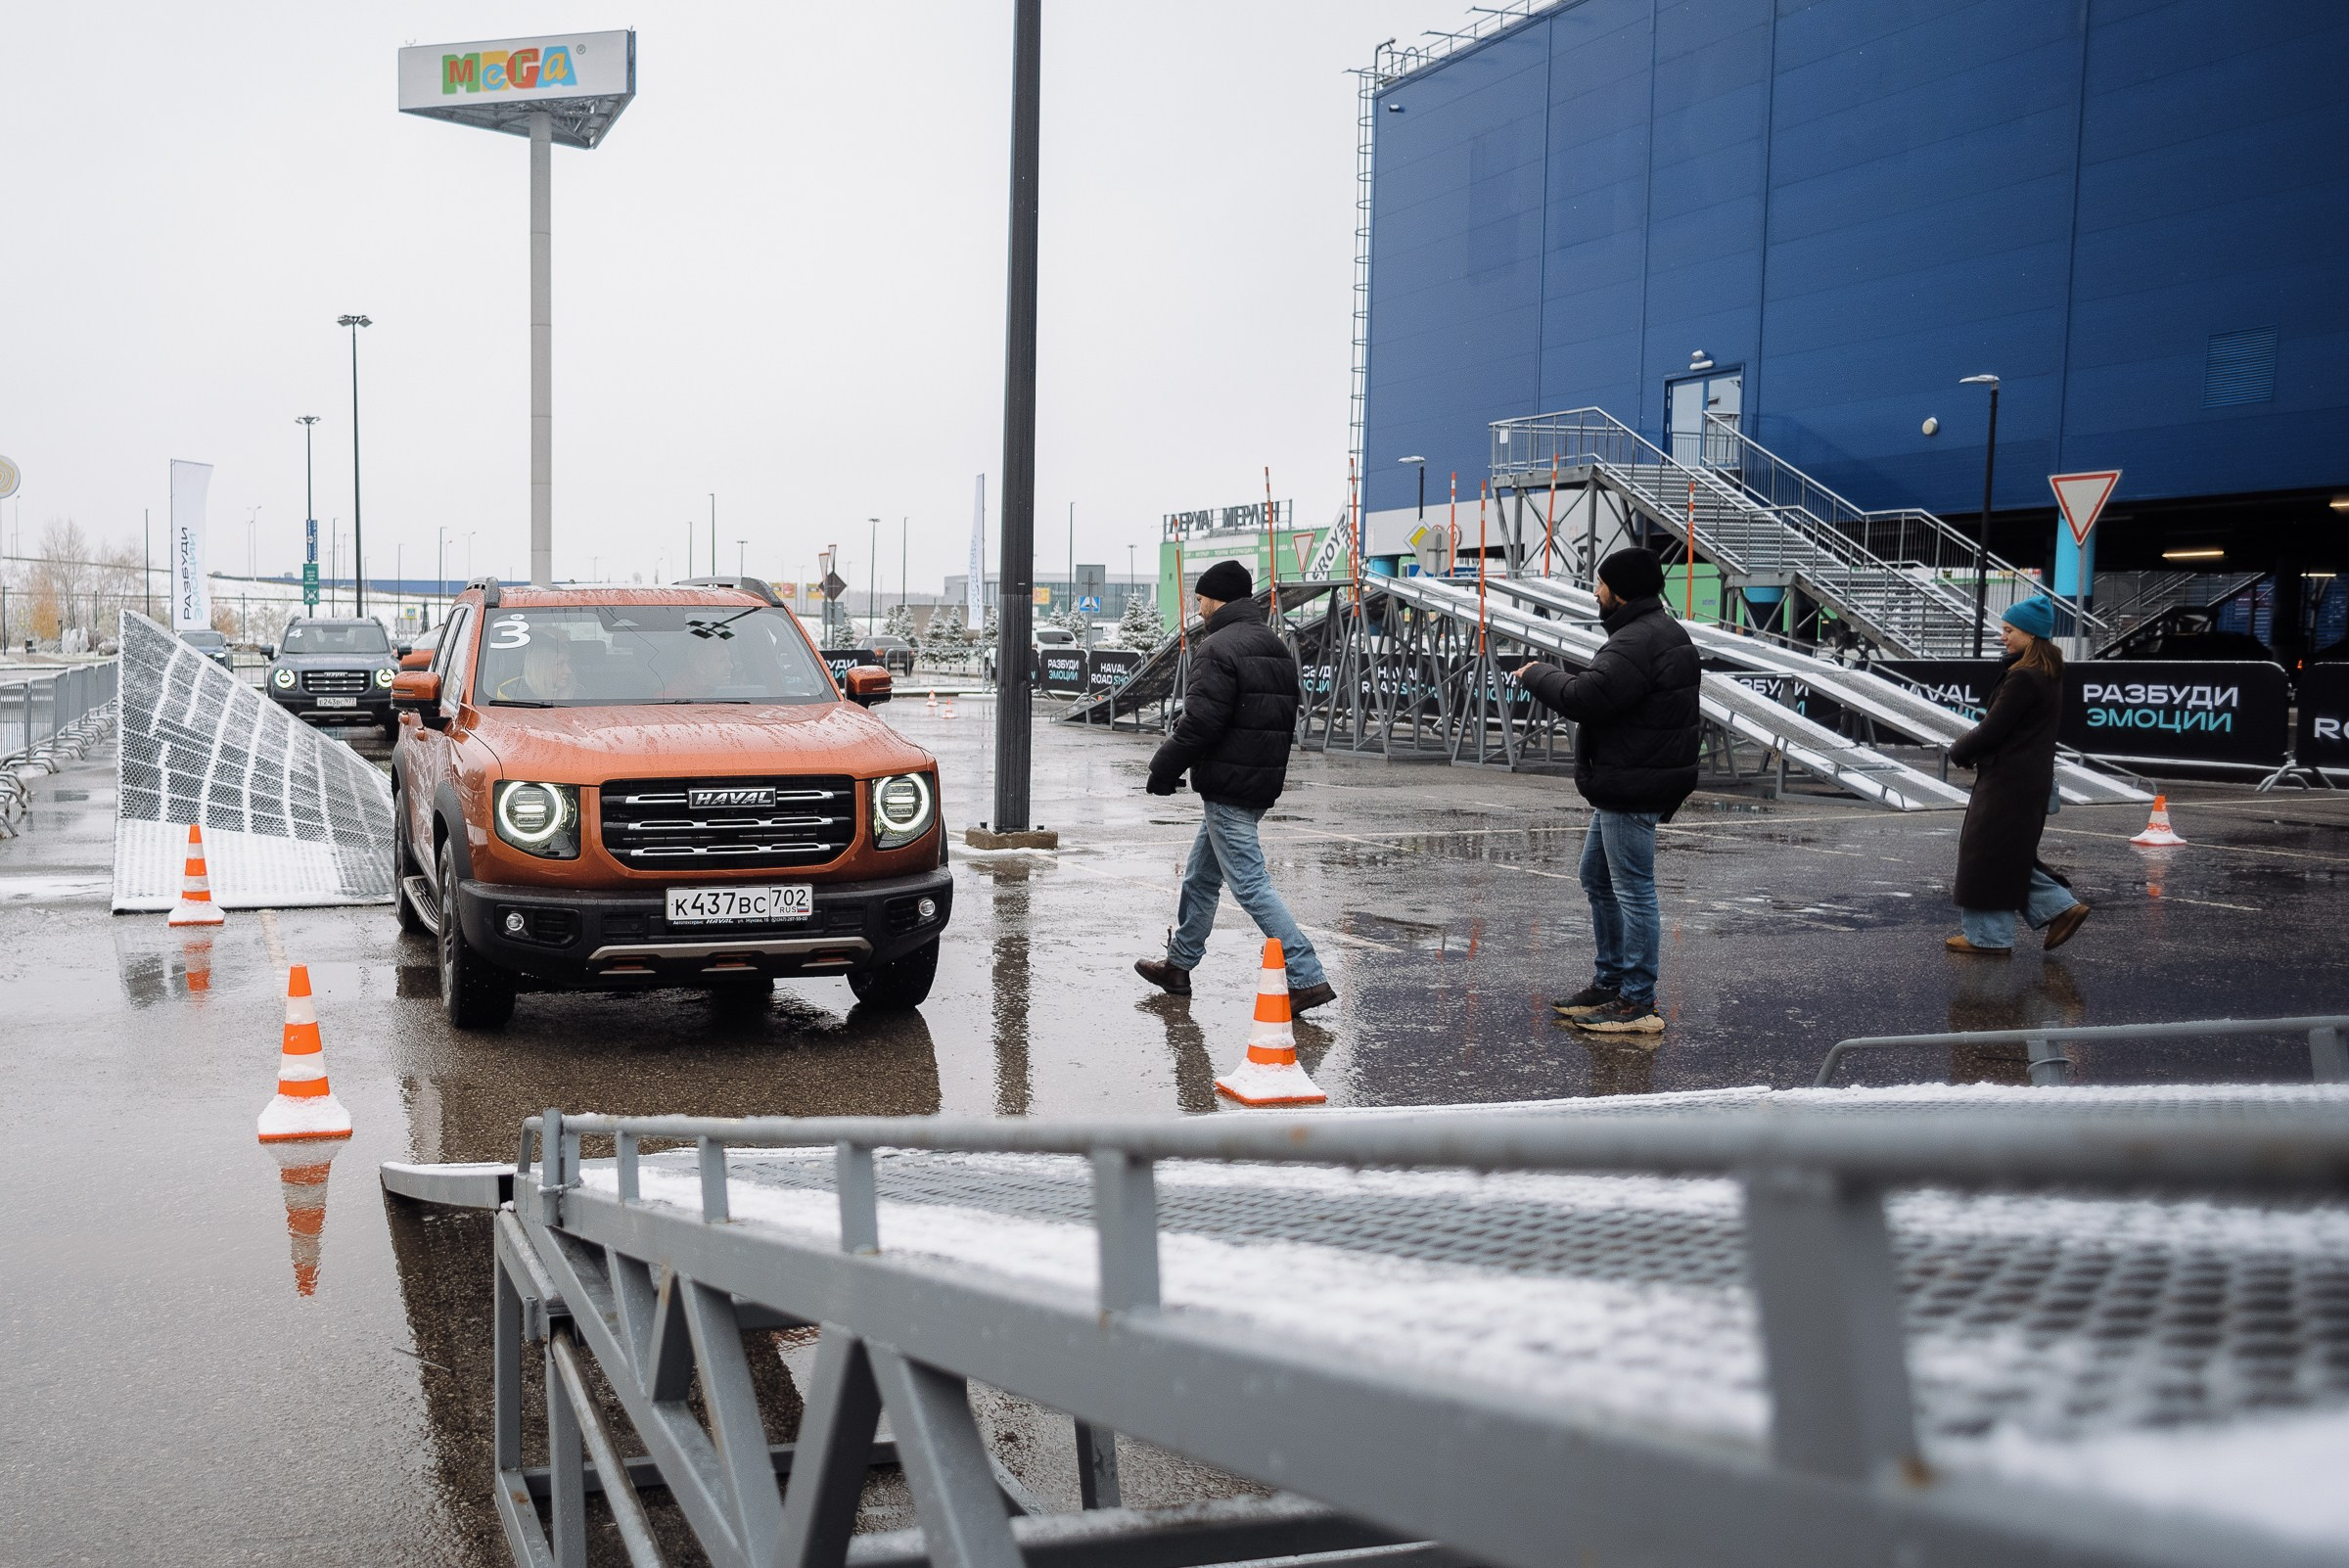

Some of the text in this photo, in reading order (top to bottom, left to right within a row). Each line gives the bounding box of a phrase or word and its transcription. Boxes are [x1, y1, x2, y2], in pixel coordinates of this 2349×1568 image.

[1222, 500, 1280, 529] МЕРЛЕН
[180, 527, 192, 620] РАЗБУДИ
[189, 532, 203, 621] ЭМОЦИИ
[288, 628, 303, 638] 4
[490, 620, 531, 649] 3
[1047, 659, 1079, 670] РАЗБУДИ
[1100, 663, 1128, 674] HAVAL
[1048, 670, 1079, 681] ЭМОЦИИ
[1090, 673, 1113, 685] ROAD
[2083, 684, 2238, 710] РАЗБУДИ
[2087, 708, 2232, 733] ЭМОЦИИ
[695, 791, 771, 806] HAVAL
[771, 889, 806, 906] 702
